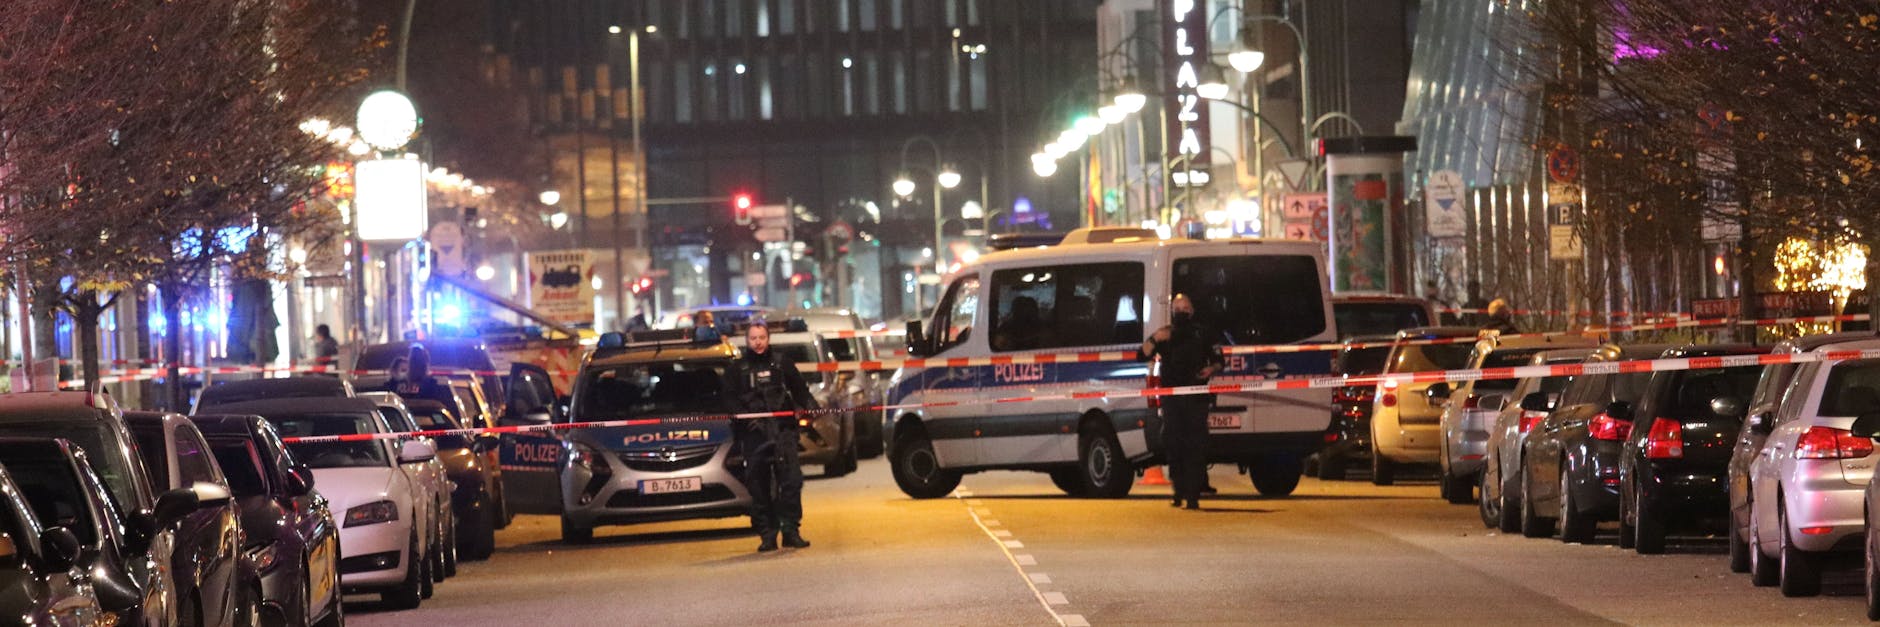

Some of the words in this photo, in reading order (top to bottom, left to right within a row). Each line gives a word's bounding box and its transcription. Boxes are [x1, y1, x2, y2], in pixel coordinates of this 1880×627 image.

[1174, 0, 1201, 154] PLAZA
[995, 363, 1044, 383] POLIZEI
[623, 430, 709, 446] POLIZEI
[514, 443, 560, 462] POLIZEI
[664, 479, 692, 490] 7613
